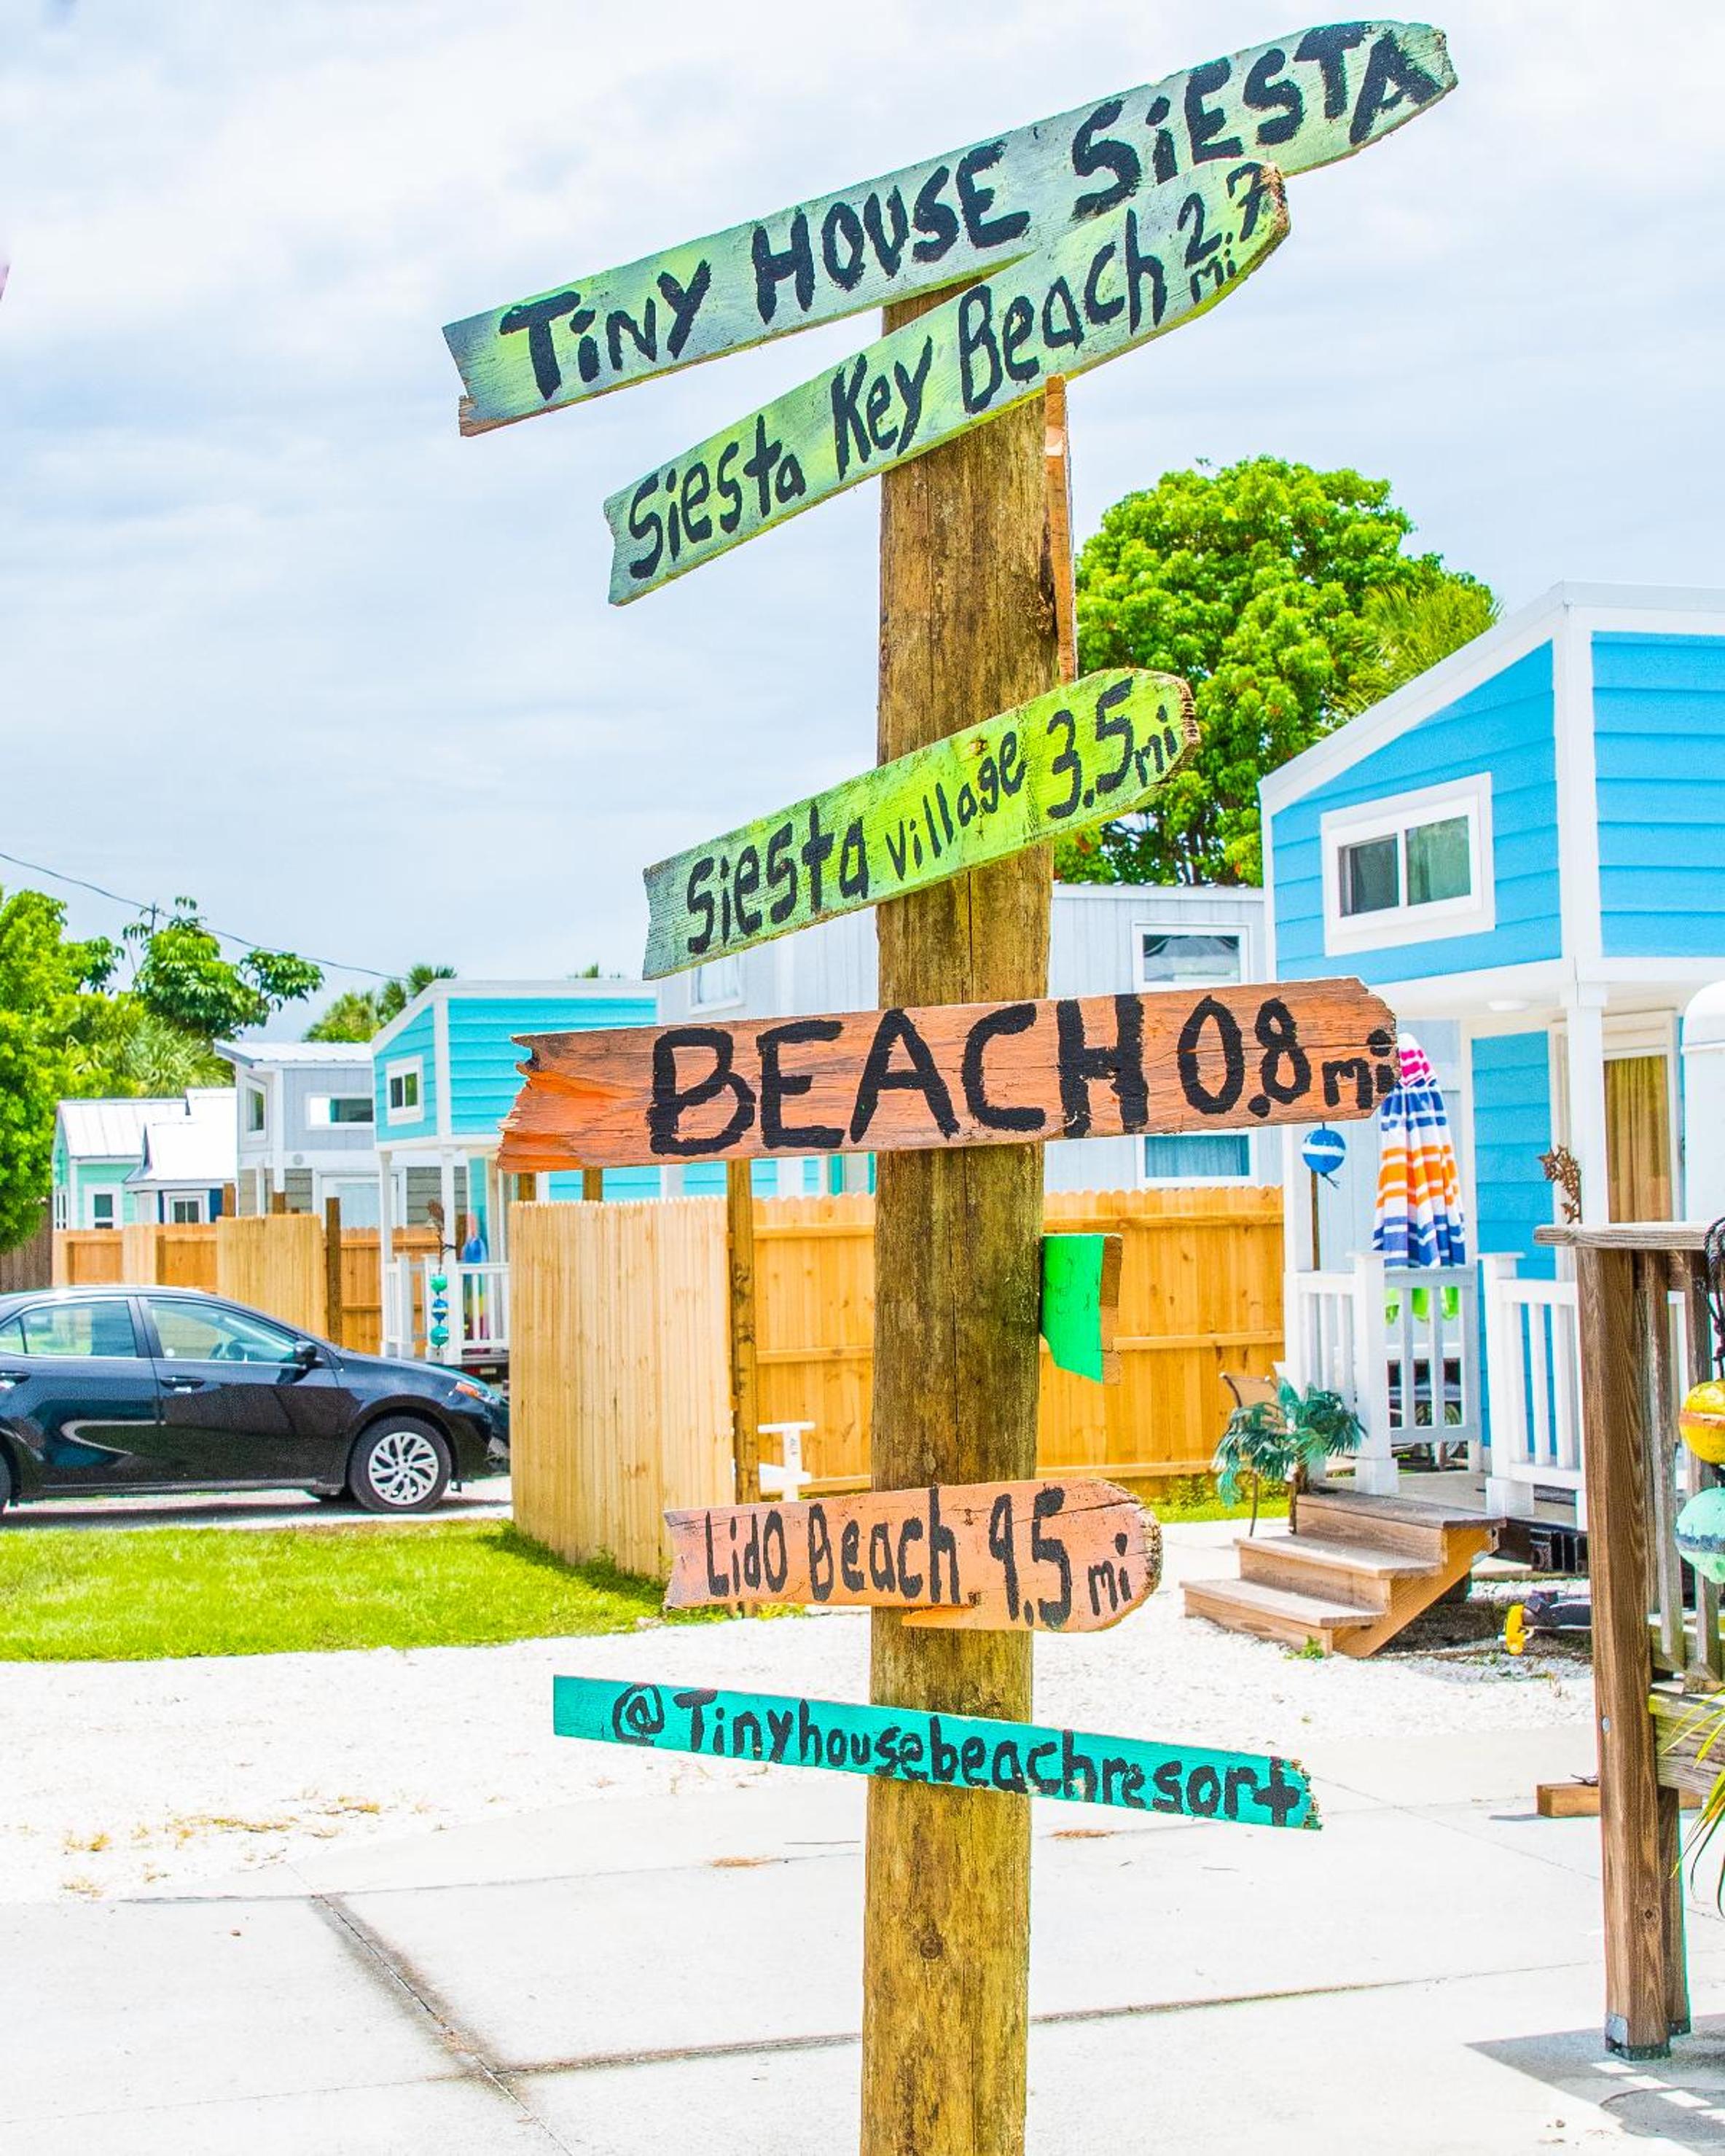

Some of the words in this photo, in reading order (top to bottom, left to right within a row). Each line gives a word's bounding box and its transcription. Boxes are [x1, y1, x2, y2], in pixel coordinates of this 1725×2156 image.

[751, 140, 1030, 325] HOUSE
[628, 413, 807, 581] Siesta
[831, 334, 933, 482] Key
[958, 208, 1167, 415] Beach
[1176, 162, 1270, 270] 2.7
[686, 799, 869, 955] Siesta
[1045, 675, 1151, 820] 3.5
[1133, 704, 1179, 788] mi
[646, 992, 1149, 1157] BEACH
[1176, 995, 1312, 1119] 0.8
[1321, 1028, 1397, 1110] mi
[808, 1483, 962, 1604] Beach
[988, 1485, 1073, 1633] 9.5
[1087, 1532, 1134, 1618] mi
